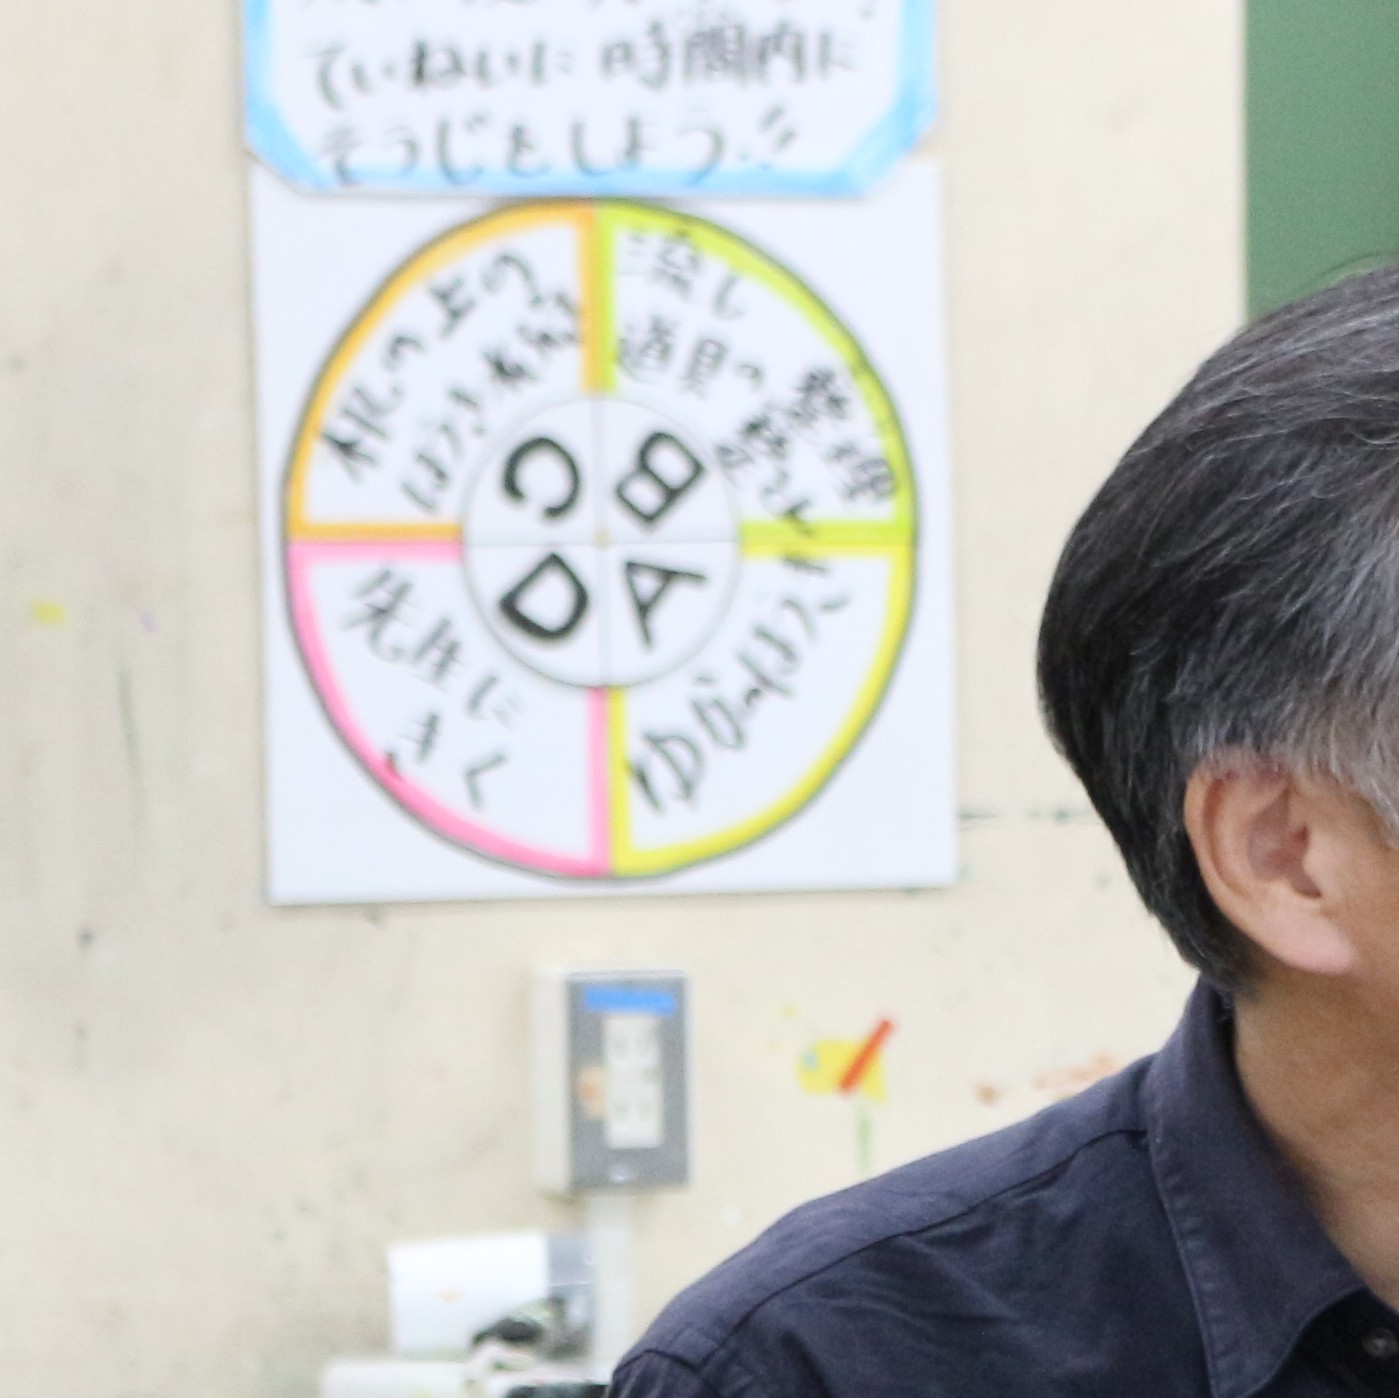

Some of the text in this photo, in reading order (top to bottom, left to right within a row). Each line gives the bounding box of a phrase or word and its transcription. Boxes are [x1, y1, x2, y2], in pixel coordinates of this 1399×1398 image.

[503, 434, 582, 520] C
[613, 430, 704, 524] B
[500, 551, 590, 643] D
[622, 557, 707, 648] A
